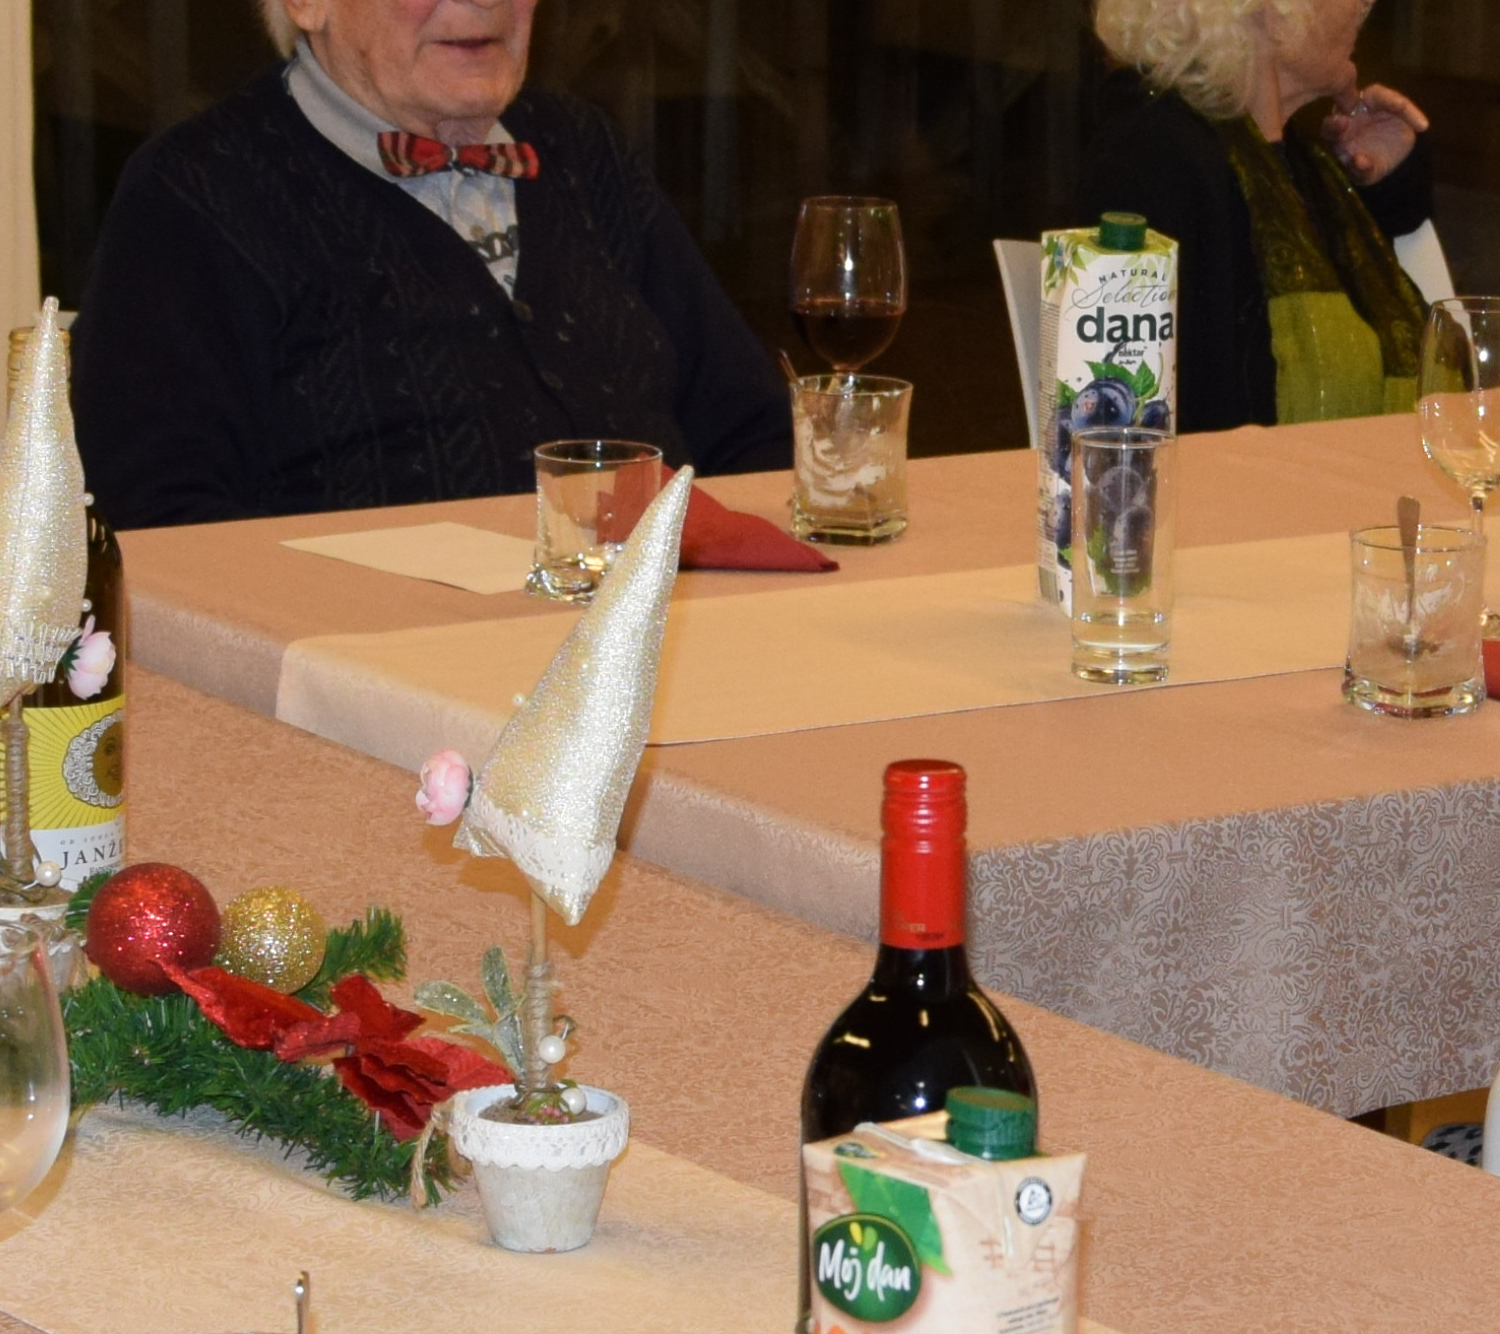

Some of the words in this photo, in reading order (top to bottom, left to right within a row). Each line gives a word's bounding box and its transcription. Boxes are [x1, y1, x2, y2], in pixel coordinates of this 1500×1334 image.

[1099, 269, 1167, 284] NATURAL
[1076, 306, 1174, 344] dana
[818, 1238, 863, 1301] Moj
[866, 1240, 911, 1302] dan
